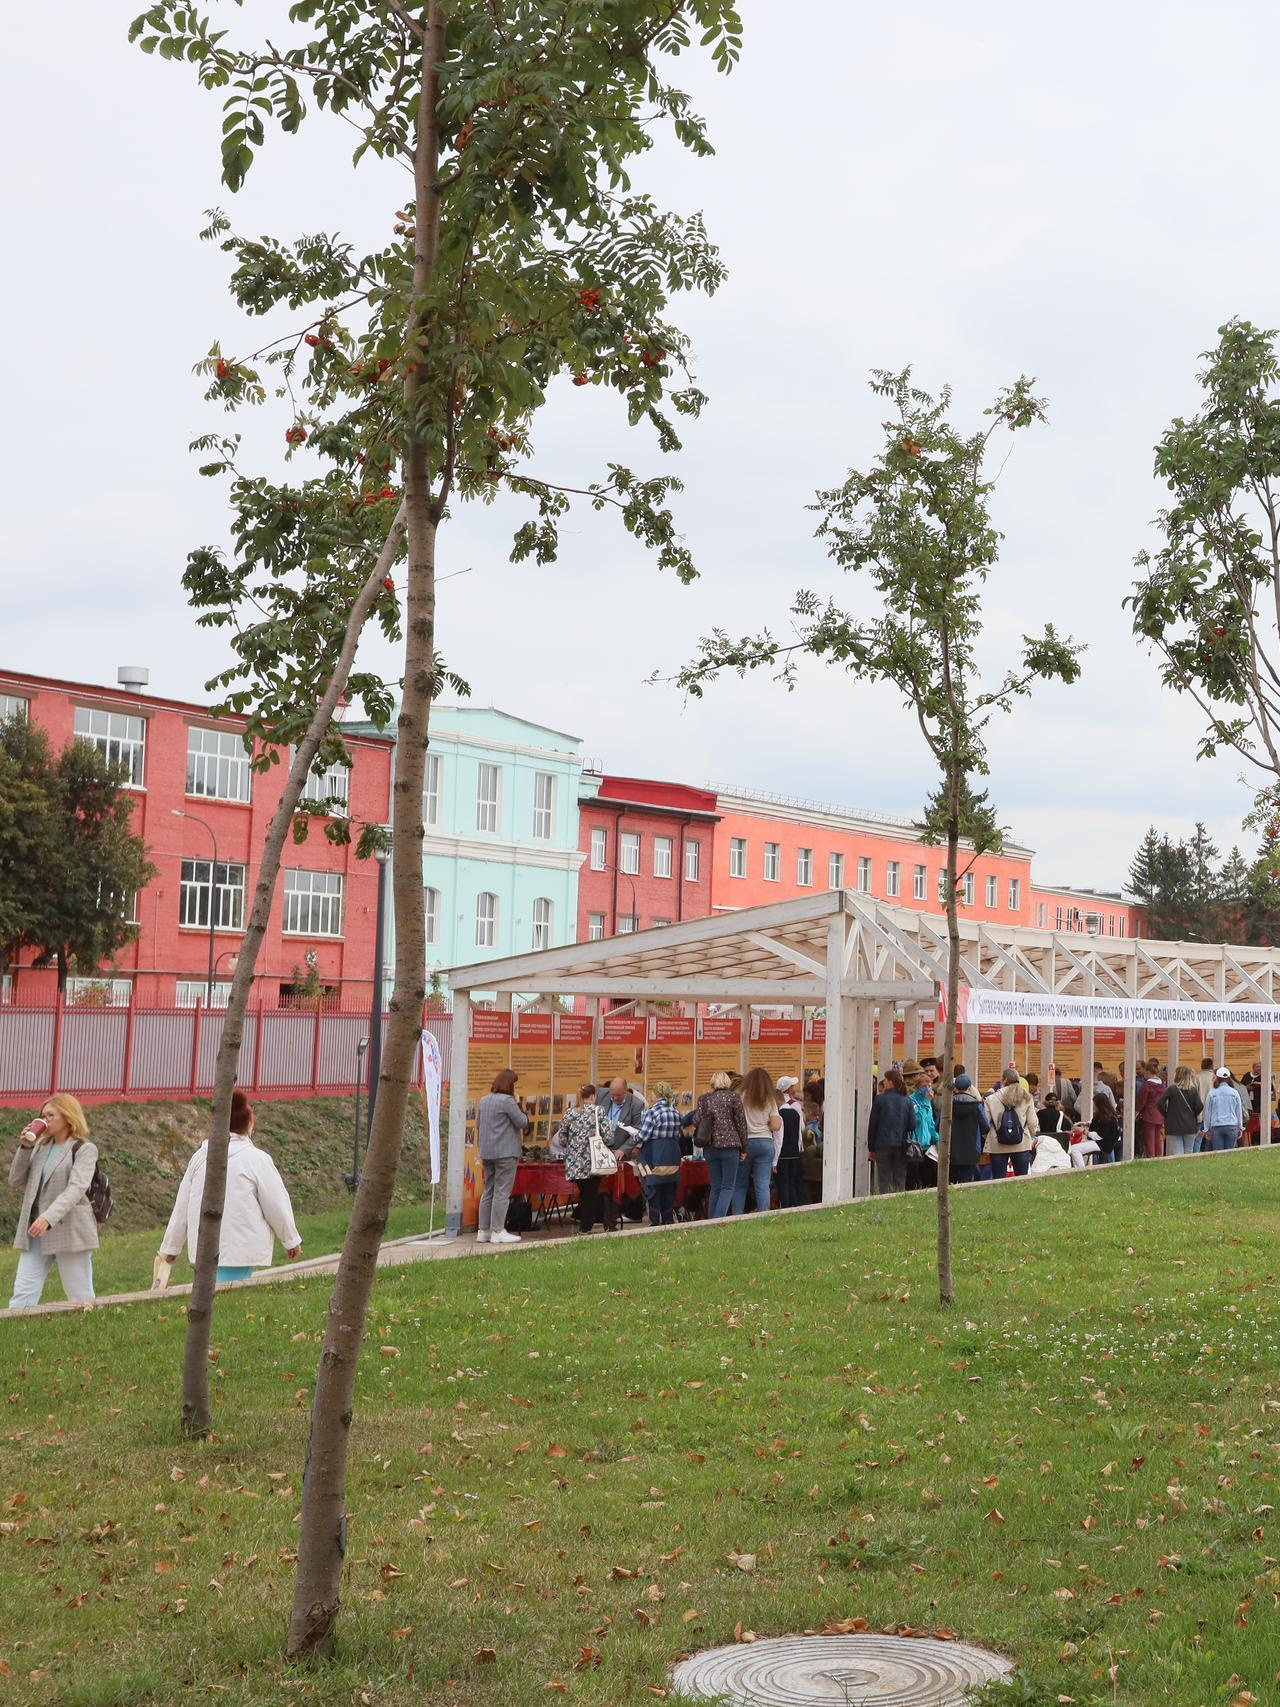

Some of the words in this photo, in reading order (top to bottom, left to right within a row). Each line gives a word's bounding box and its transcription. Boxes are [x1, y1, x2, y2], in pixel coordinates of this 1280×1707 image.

[1018, 998, 1055, 1019] общественно
[1056, 1003, 1088, 1018] значимых
[1090, 1005, 1123, 1023] проектов
[1125, 1006, 1129, 1020] и
[1131, 1007, 1151, 1024] услуг
[1154, 1008, 1195, 1024] социально
[1197, 1009, 1271, 1026] ориентированных
